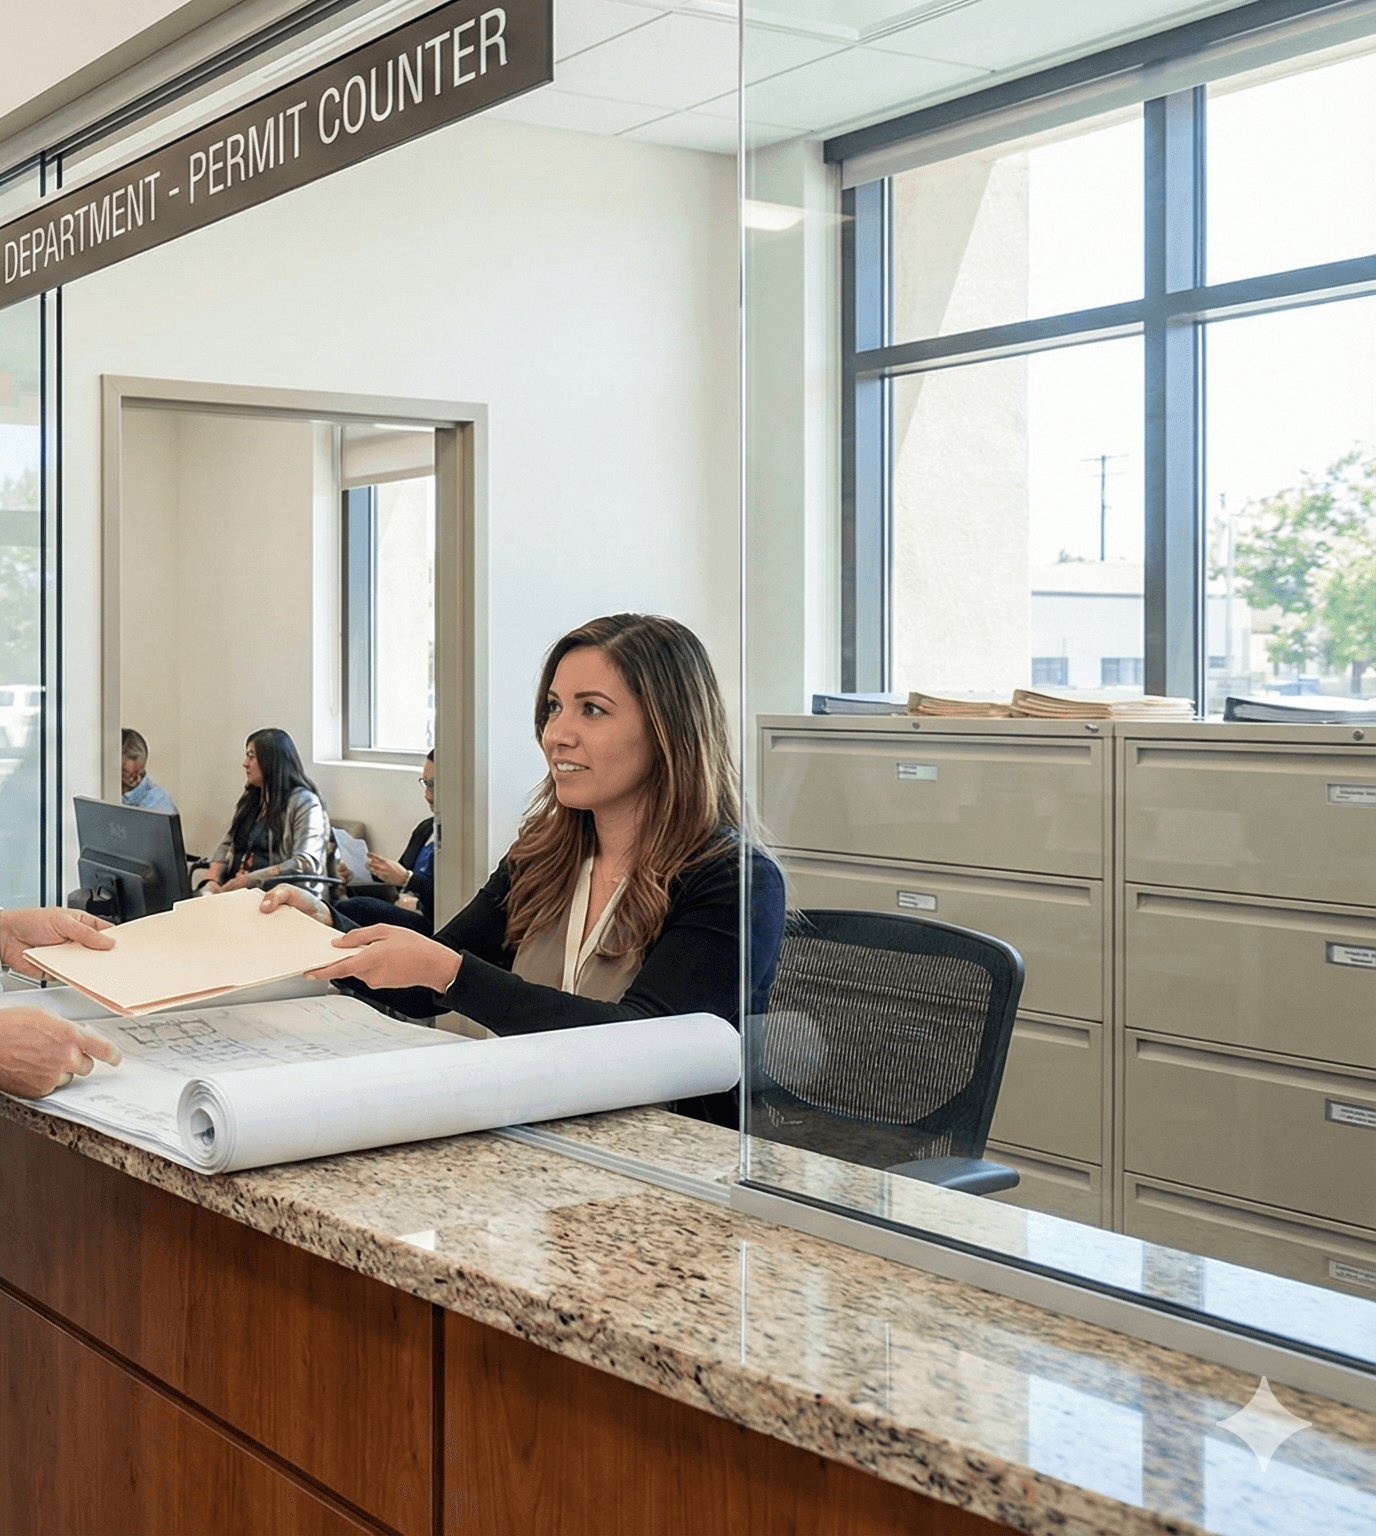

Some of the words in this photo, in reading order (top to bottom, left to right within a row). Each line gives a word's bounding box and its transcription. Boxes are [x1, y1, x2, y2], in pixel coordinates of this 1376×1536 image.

[4, 171, 161, 285] DEPARTMENT
[168, 186, 181, 197] -
[189, 101, 308, 204] PERMIT
[318, 7, 509, 146] COUNTER
